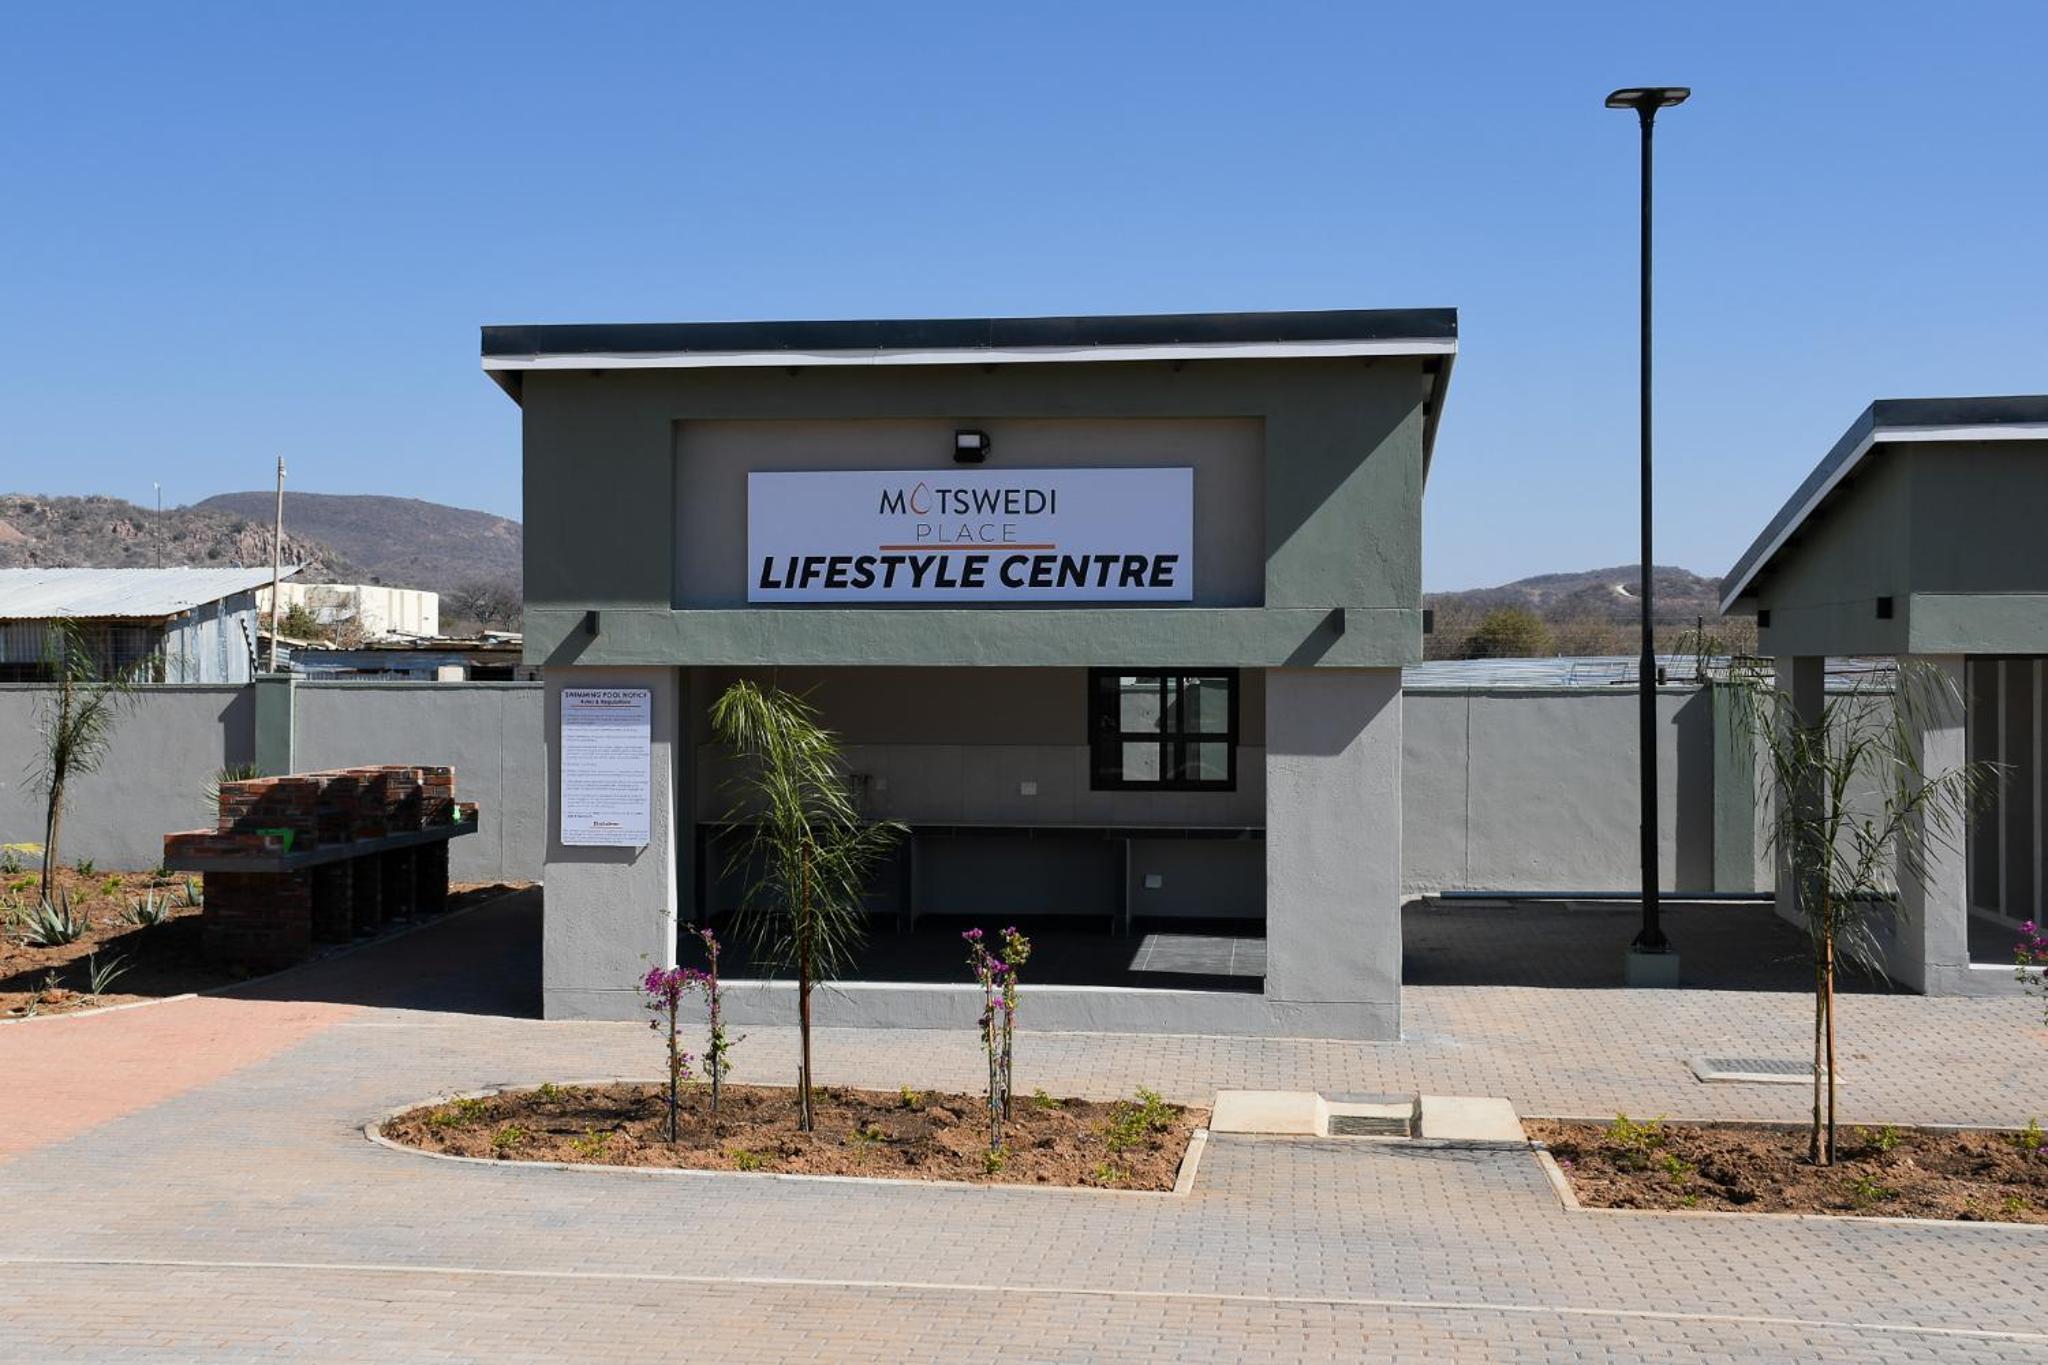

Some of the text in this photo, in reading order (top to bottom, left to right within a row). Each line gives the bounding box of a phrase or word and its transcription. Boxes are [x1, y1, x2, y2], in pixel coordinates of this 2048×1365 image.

[879, 481, 1056, 515] MOTSWEDI
[916, 523, 1017, 543] PLACE
[759, 554, 1179, 589] LIFESTYLE CENTRE
